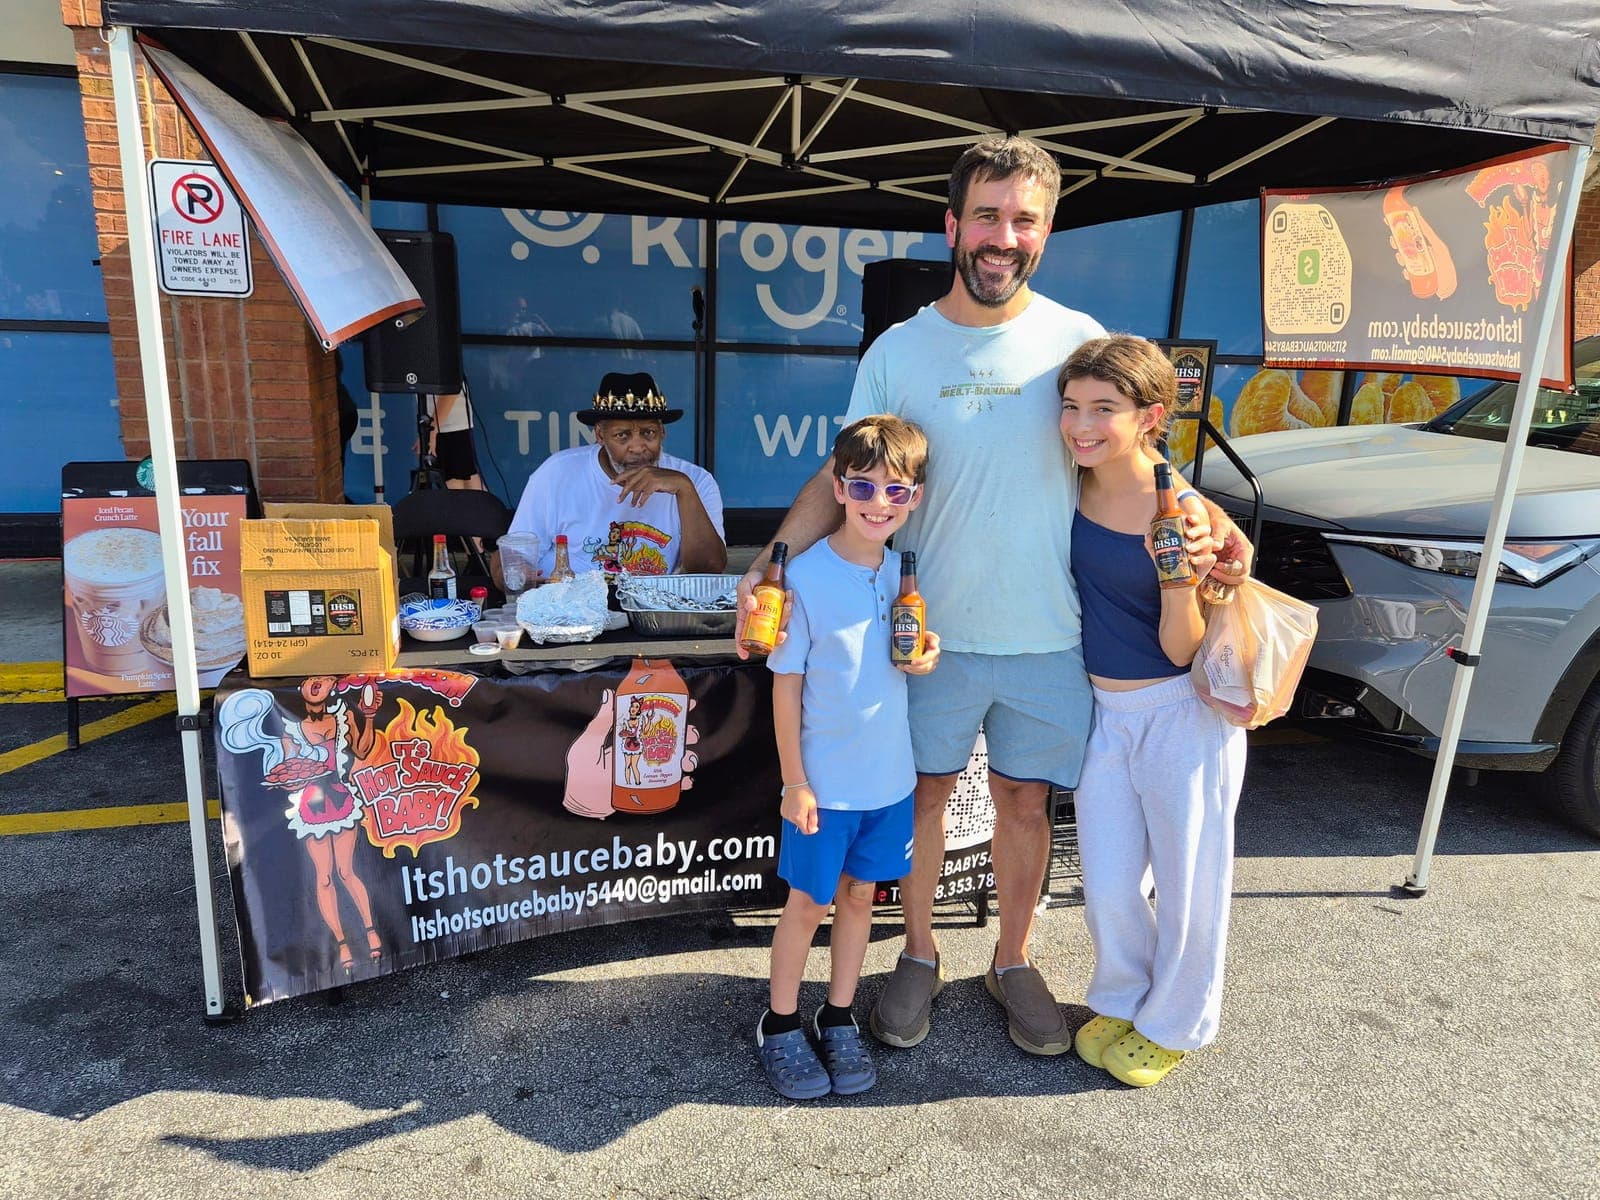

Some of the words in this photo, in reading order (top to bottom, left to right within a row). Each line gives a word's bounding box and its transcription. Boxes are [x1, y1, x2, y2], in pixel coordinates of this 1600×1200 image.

[162, 229, 194, 246] FIRE
[202, 231, 241, 248] LANE
[166, 248, 208, 257] VIOLATORS
[210, 250, 227, 258] WILL
[231, 251, 241, 259] BE
[174, 257, 199, 265] TOWED
[202, 258, 221, 266] AWAY
[171, 265, 202, 274] OWNERS
[205, 266, 239, 276] EXPENSE
[631, 215, 924, 330] Kroger
[1174, 367, 1201, 378] IHSB
[939, 386, 1021, 399] MELT-BANANA
[754, 414, 846, 457] WI
[94, 514, 120, 522] Crunch
[120, 513, 138, 521] Latte
[181, 508, 230, 528] Your
[188, 531, 224, 552] fall
[191, 555, 222, 576] fix
[330, 603, 355, 611] IHSB
[895, 623, 918, 632] IHSB
[254, 639, 288, 648] 24-414)
[290, 638, 308, 647] (GPI
[254, 651, 269, 660] OZ.
[271, 651, 282, 659] 10
[348, 649, 367, 657] PCS.
[369, 649, 379, 657] 12
[1219, 644, 1234, 669] Kroger
[393, 739, 430, 759] IT'S
[354, 763, 401, 805] HOT
[401, 757, 476, 793] SAUCE
[374, 789, 459, 837] BABY!
[401, 832, 775, 905] Itshotsaucebaby.com
[934, 872, 996, 900] 8.353.78
[411, 869, 762, 943] Itshotsaucebaby5440@gmail.com
